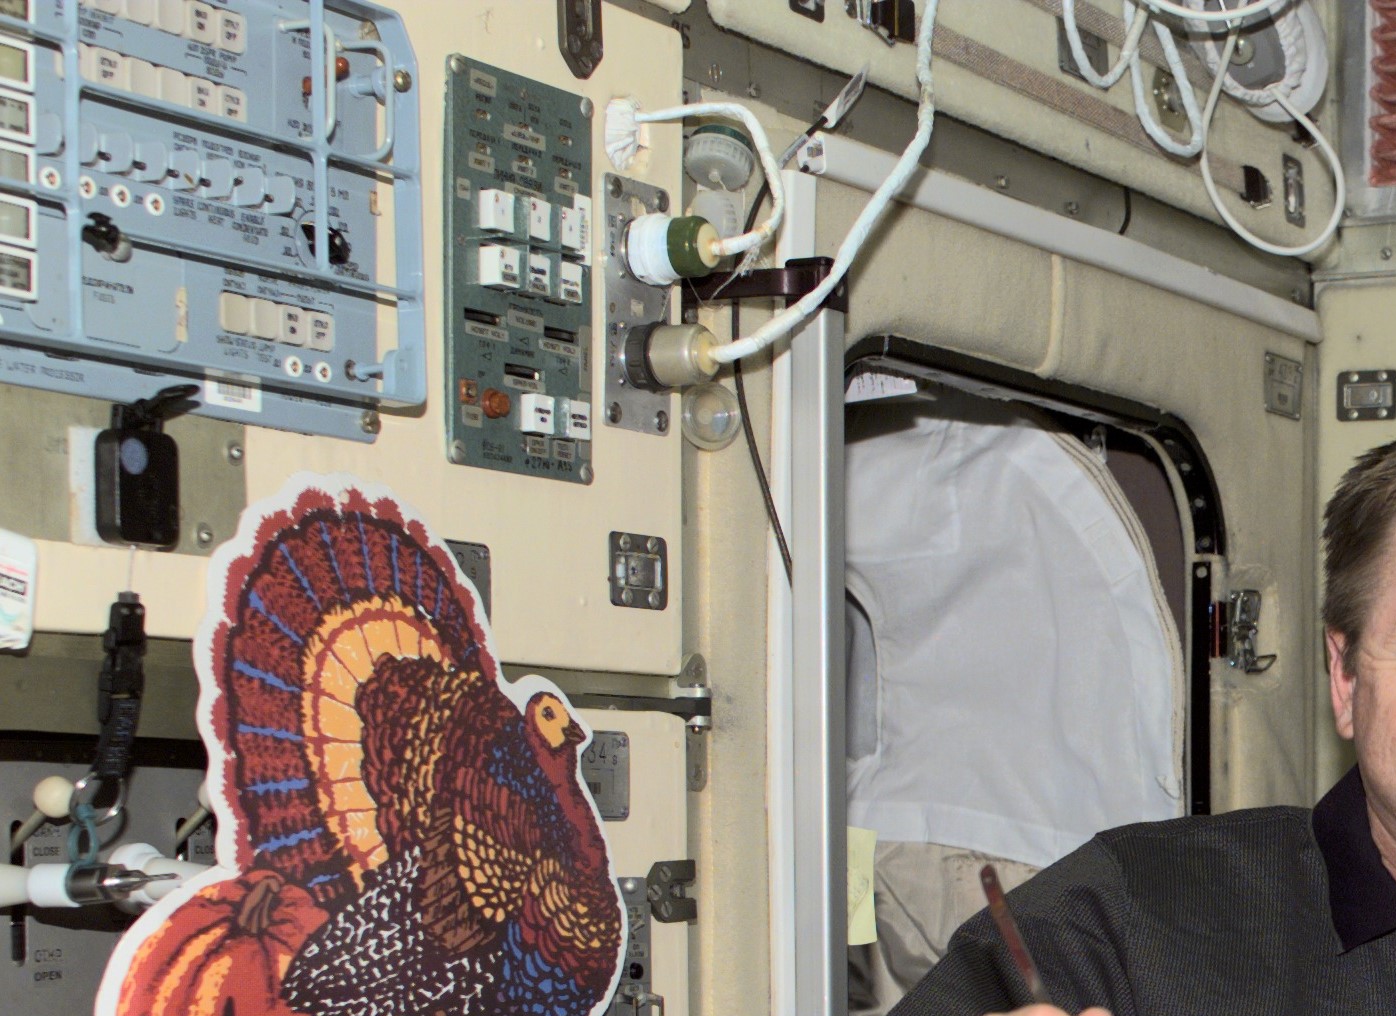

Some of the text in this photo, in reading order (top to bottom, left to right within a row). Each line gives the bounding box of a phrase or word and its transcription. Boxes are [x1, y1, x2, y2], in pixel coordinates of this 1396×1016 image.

[32, 846, 60, 858] CLOSE
[194, 845, 216, 856] CLOS
[34, 970, 62, 983] OPEN
